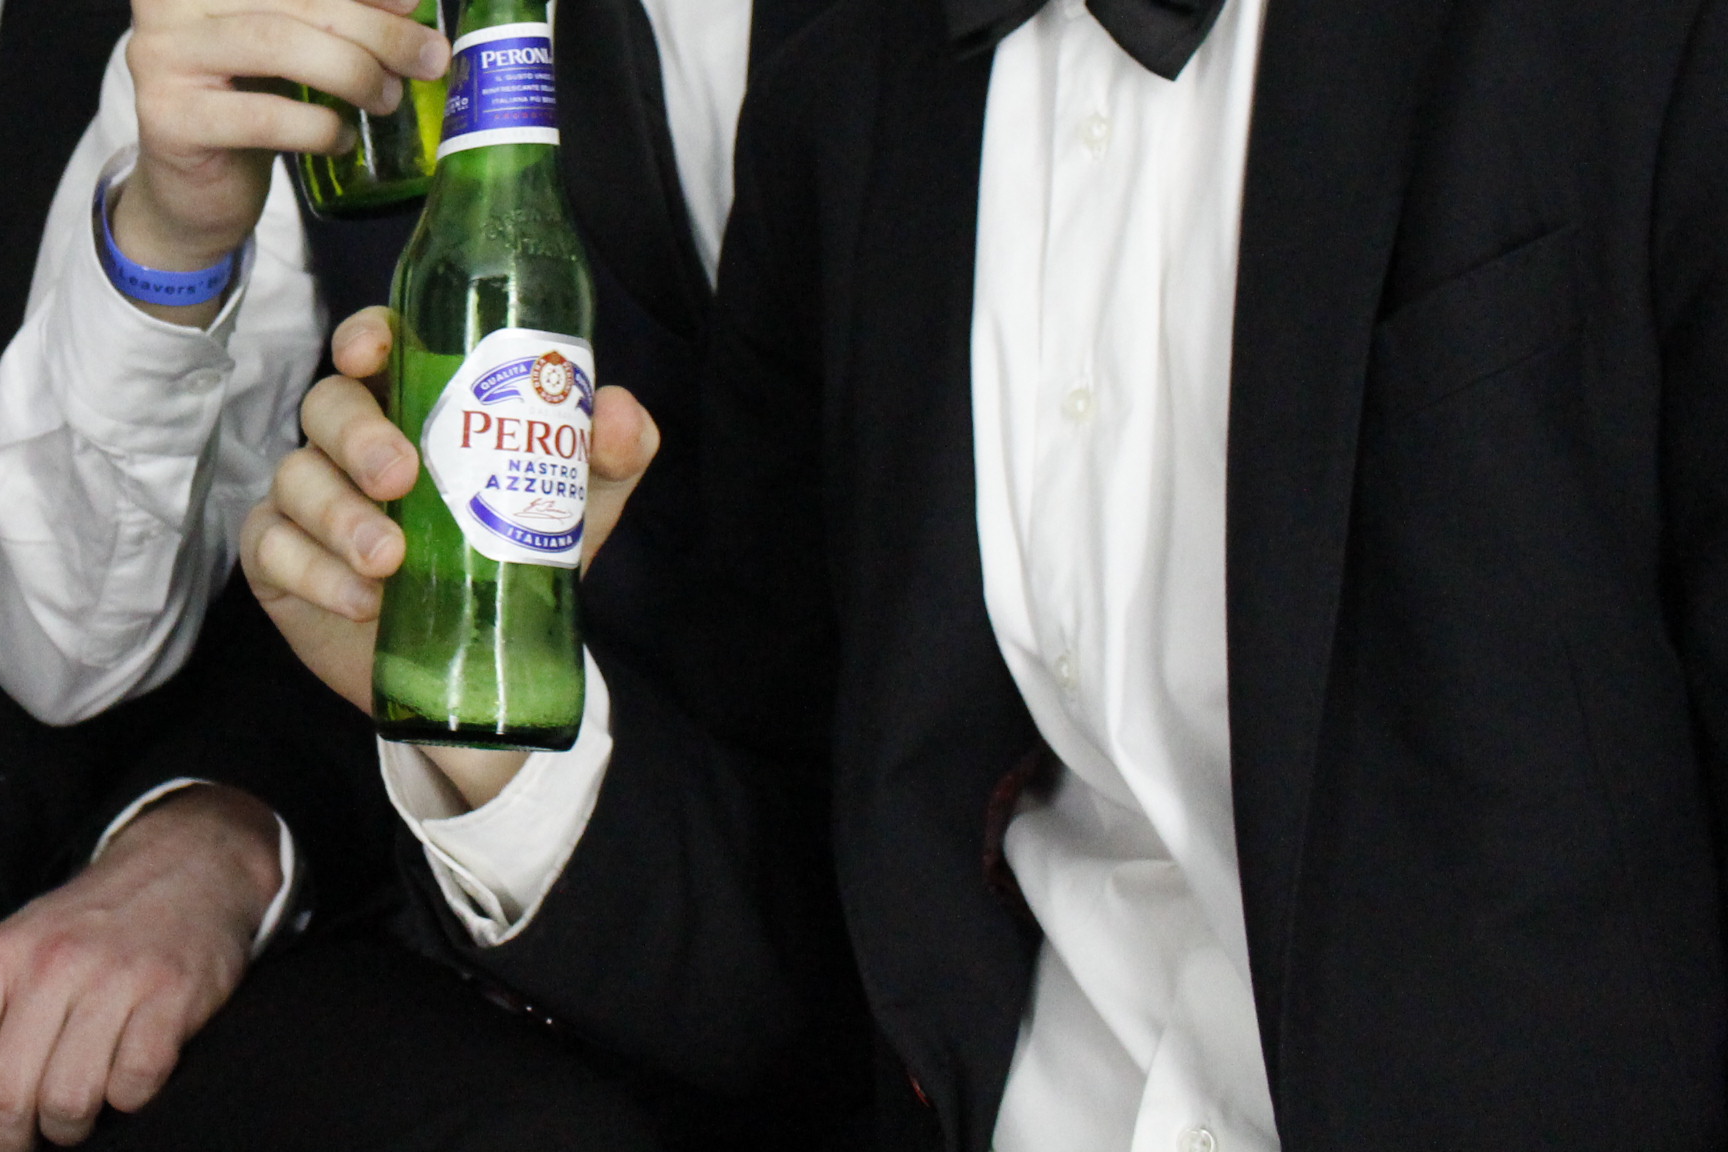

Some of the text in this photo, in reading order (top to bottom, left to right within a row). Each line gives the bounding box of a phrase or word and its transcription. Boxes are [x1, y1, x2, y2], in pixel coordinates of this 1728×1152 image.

[459, 409, 590, 465] PERON
[508, 459, 578, 480] NASTRO
[485, 474, 585, 501] AZZURRO
[506, 526, 573, 548] ITALIANA
